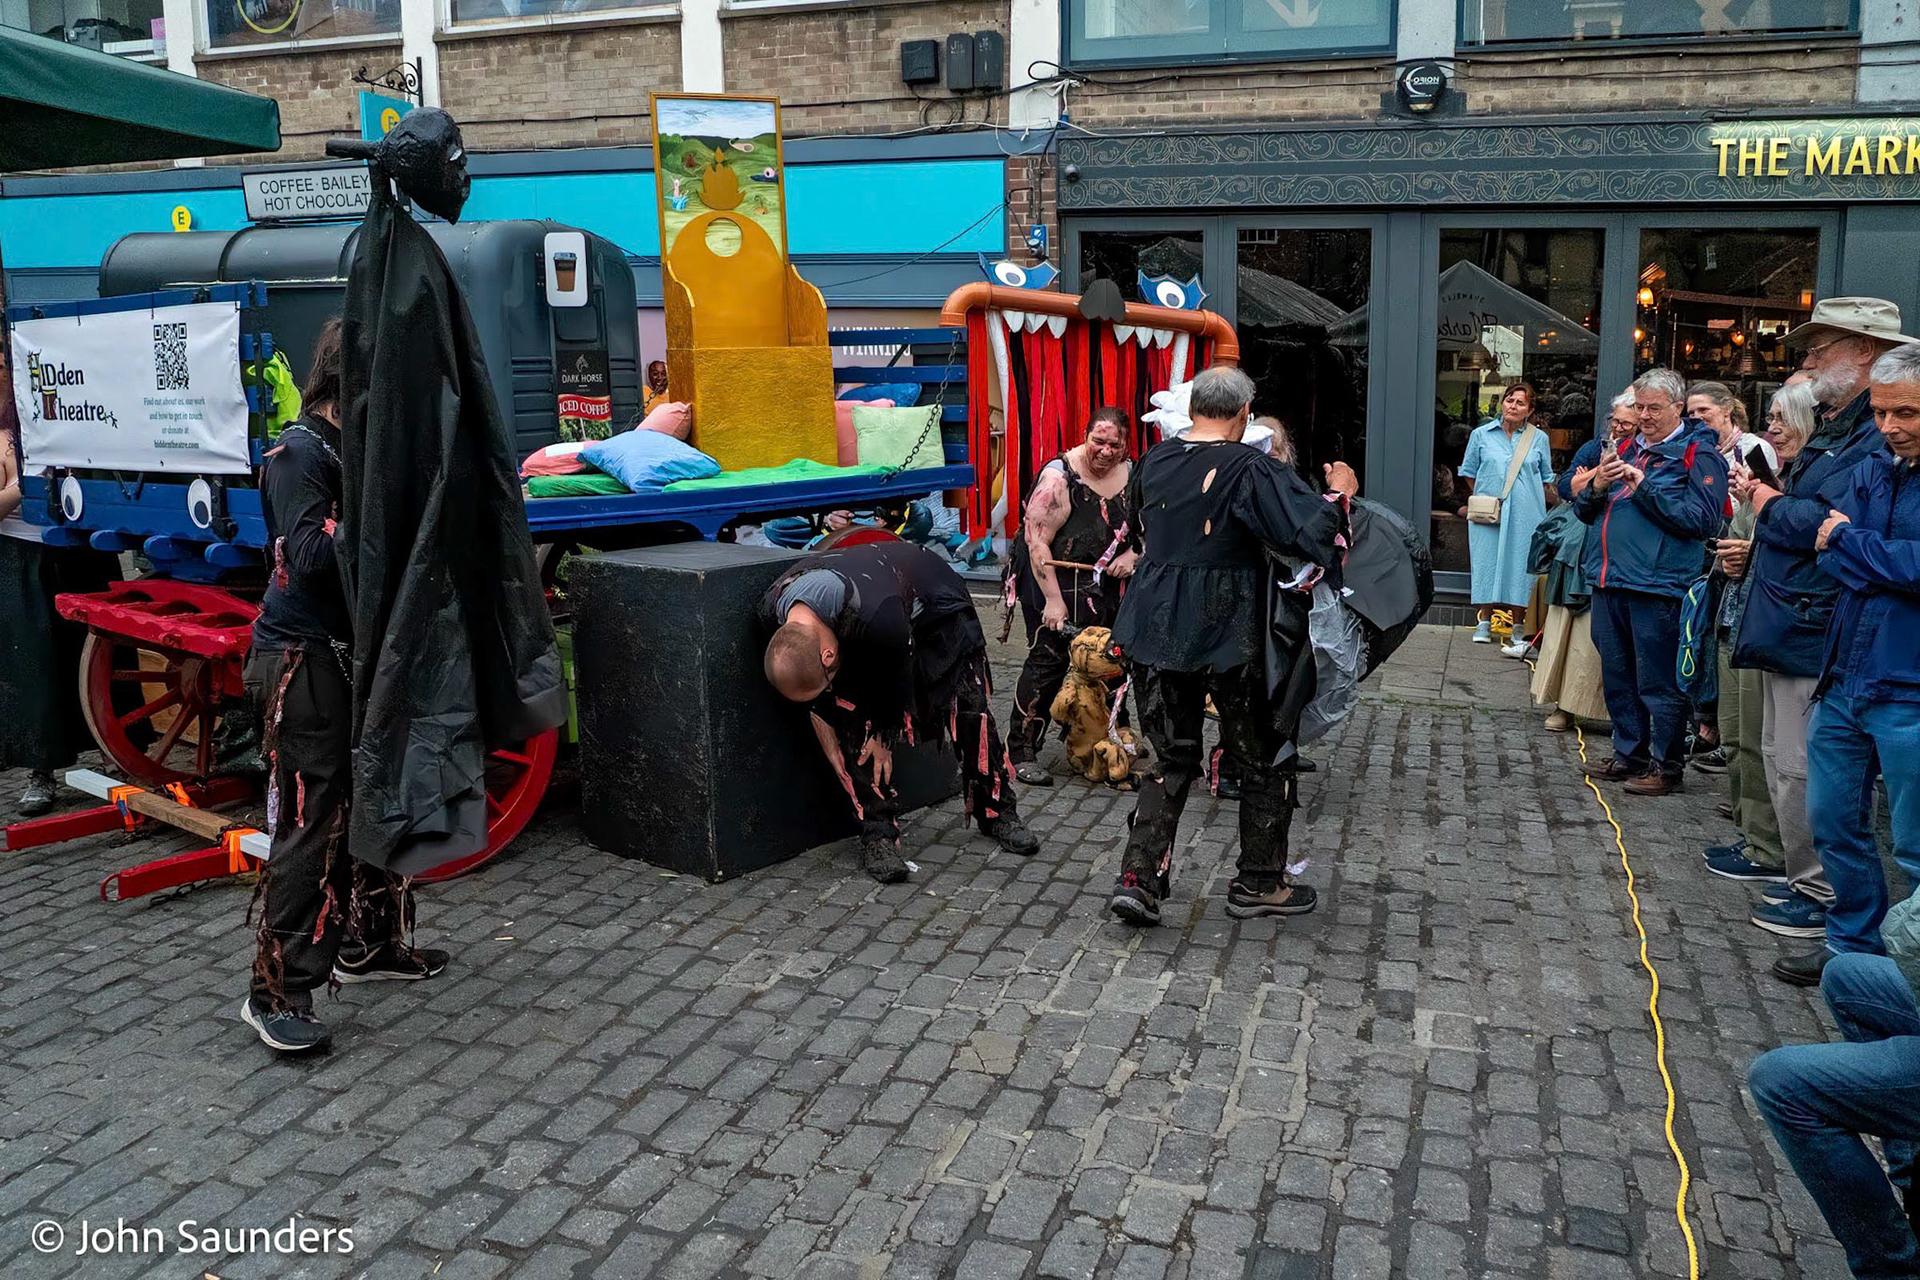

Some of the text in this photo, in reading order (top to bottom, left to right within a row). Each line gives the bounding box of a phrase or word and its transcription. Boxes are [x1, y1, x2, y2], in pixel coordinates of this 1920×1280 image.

[1712, 137, 1791, 177] THE
[260, 177, 314, 195] COFFEE
[264, 192, 372, 212] HOT CHOCOLAT
[178, 211, 186, 225] E
[561, 373, 603, 383] DARK HORSE
[143, 397, 154, 406] Find
[163, 397, 177, 405] about
[194, 396, 206, 405] work
[559, 400, 611, 416] ICED COFFEE
[174, 413, 182, 422] get
[189, 411, 203, 420] touch
[153, 440, 200, 449] hiddentheatre.com
